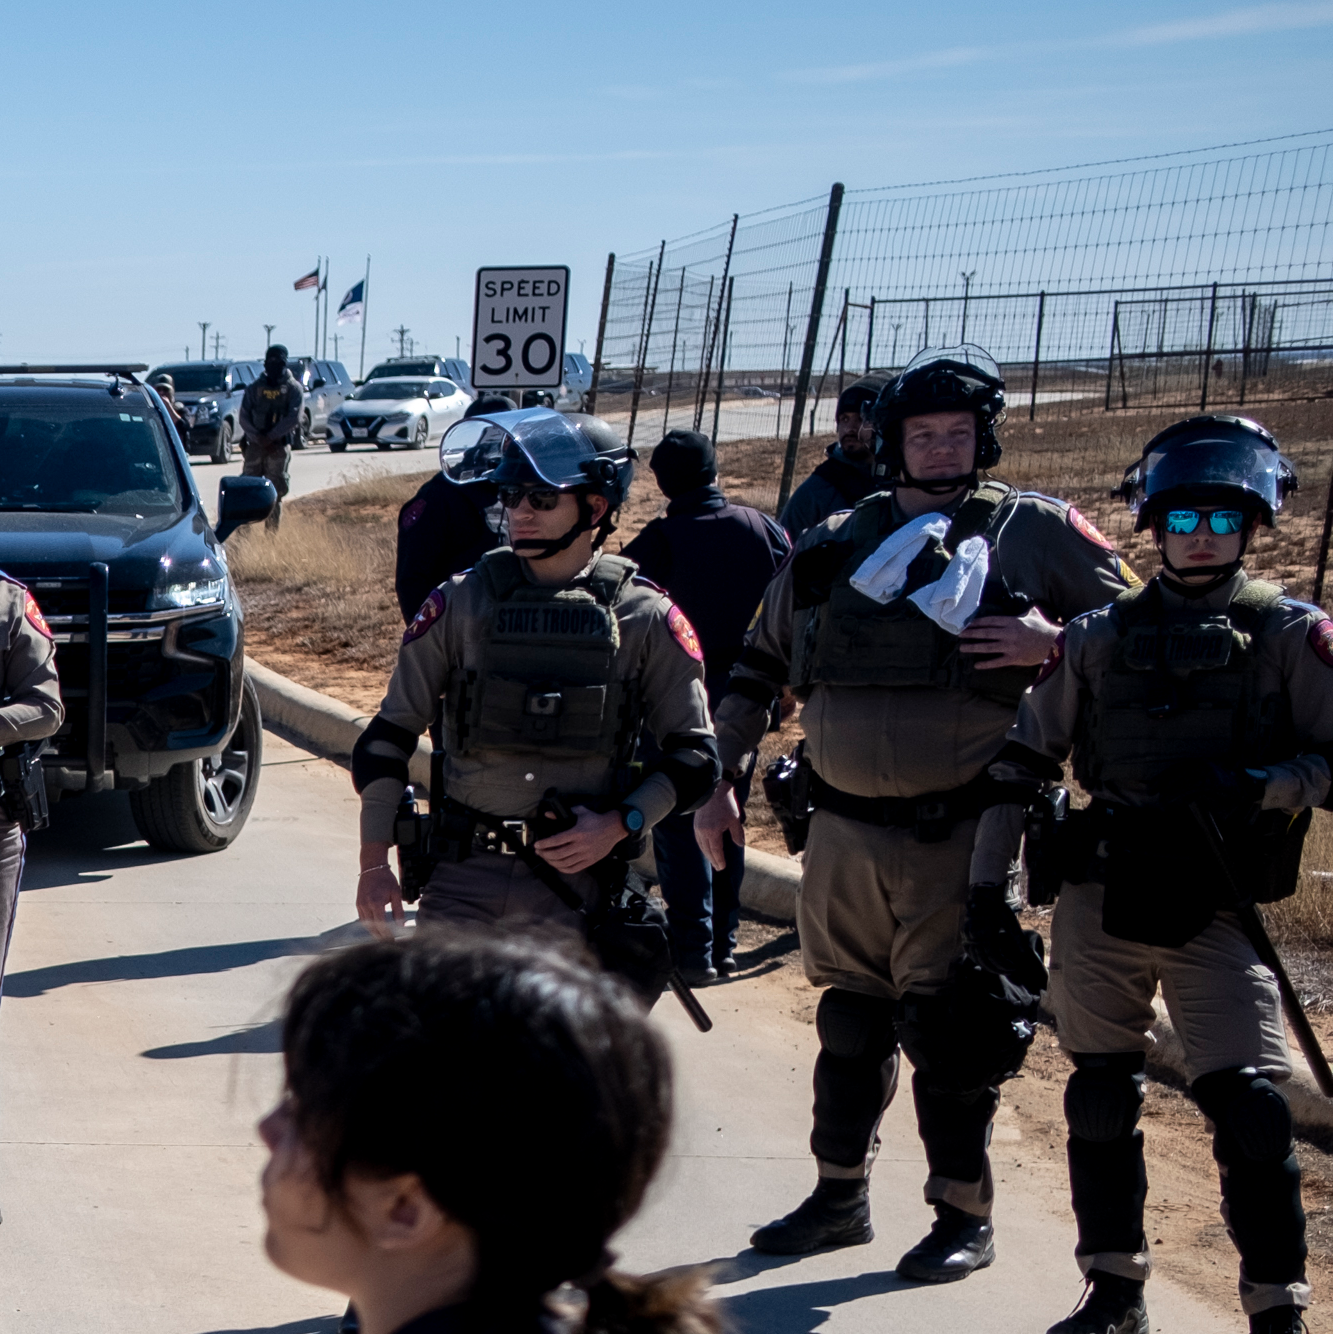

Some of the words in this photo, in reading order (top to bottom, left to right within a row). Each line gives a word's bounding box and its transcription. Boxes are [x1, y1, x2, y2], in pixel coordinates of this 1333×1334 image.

[484, 280, 561, 297] SPEED
[491, 306, 550, 323] LIMIT
[479, 332, 556, 376] 30
[496, 608, 539, 633] STATE
[1167, 634, 1223, 661] TROOPER
